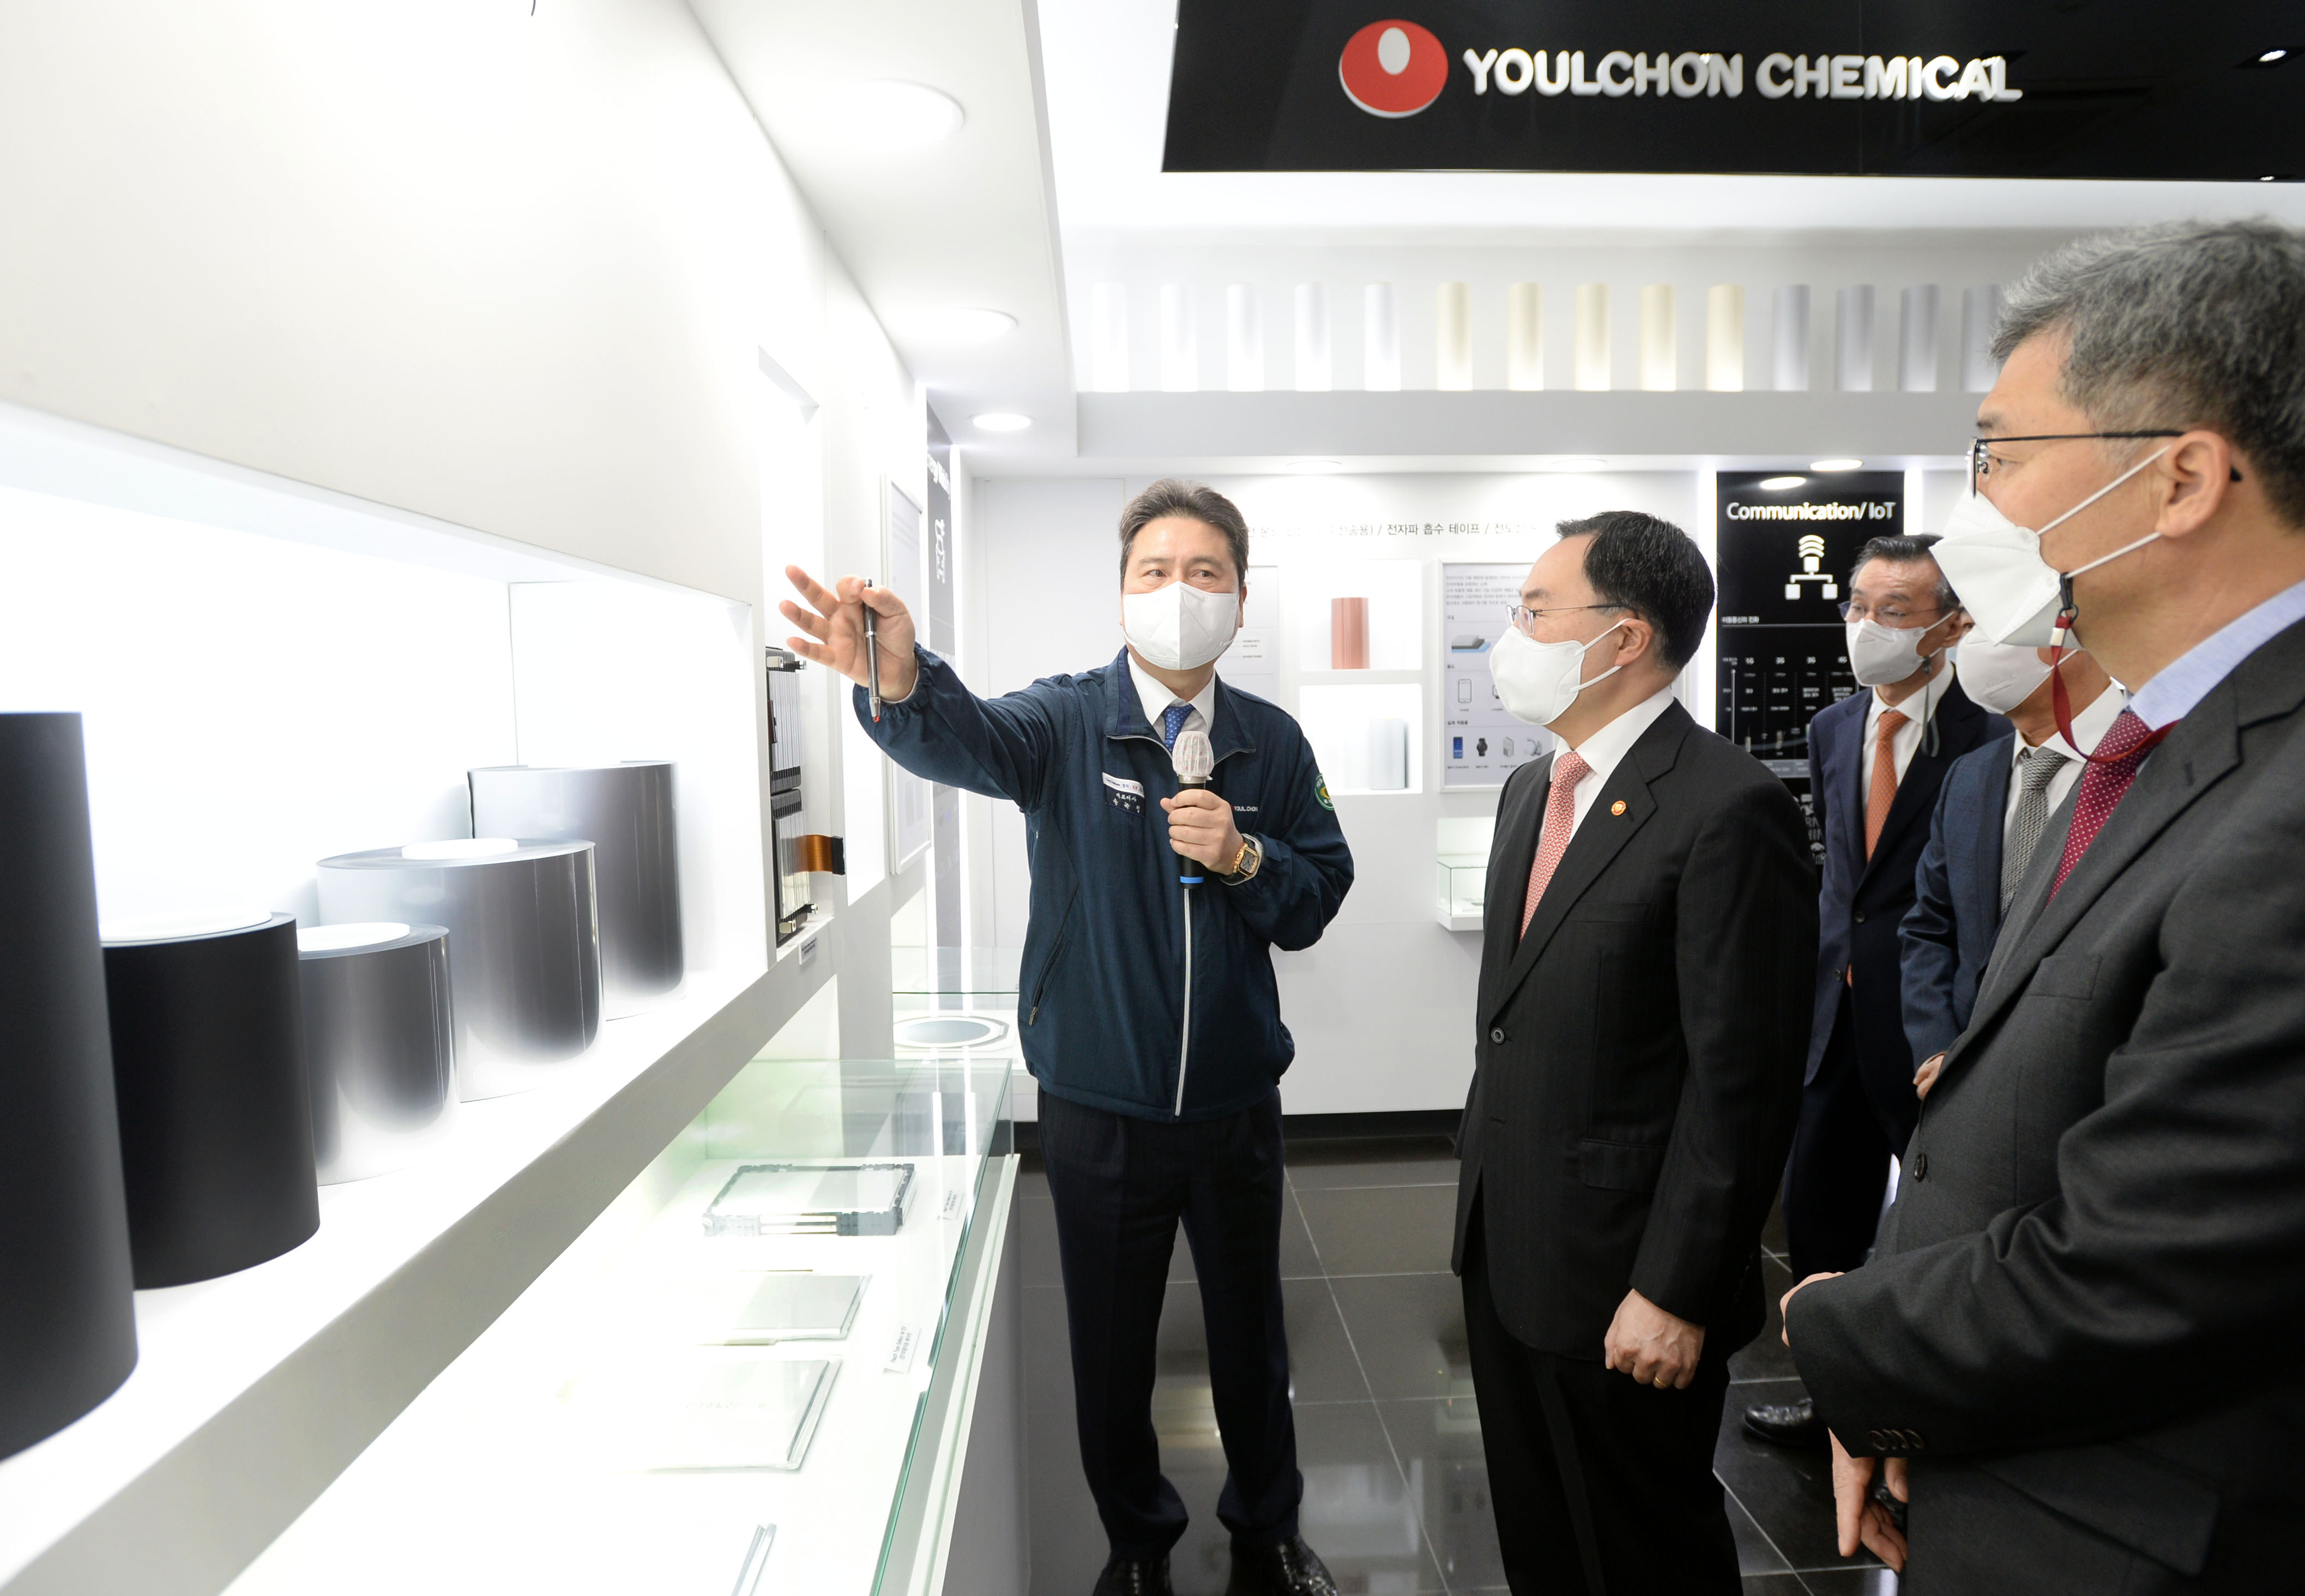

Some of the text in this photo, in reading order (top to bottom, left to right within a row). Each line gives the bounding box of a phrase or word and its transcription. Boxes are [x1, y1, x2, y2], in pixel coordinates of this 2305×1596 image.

[1463, 47, 2023, 102] YOULCHON CHEMICAL
[1868, 501, 1896, 519] IoT
[1387, 523, 1419, 536] 전자파
[1423, 523, 1444, 535] 흡수
[1449, 523, 1480, 535] 테이프
